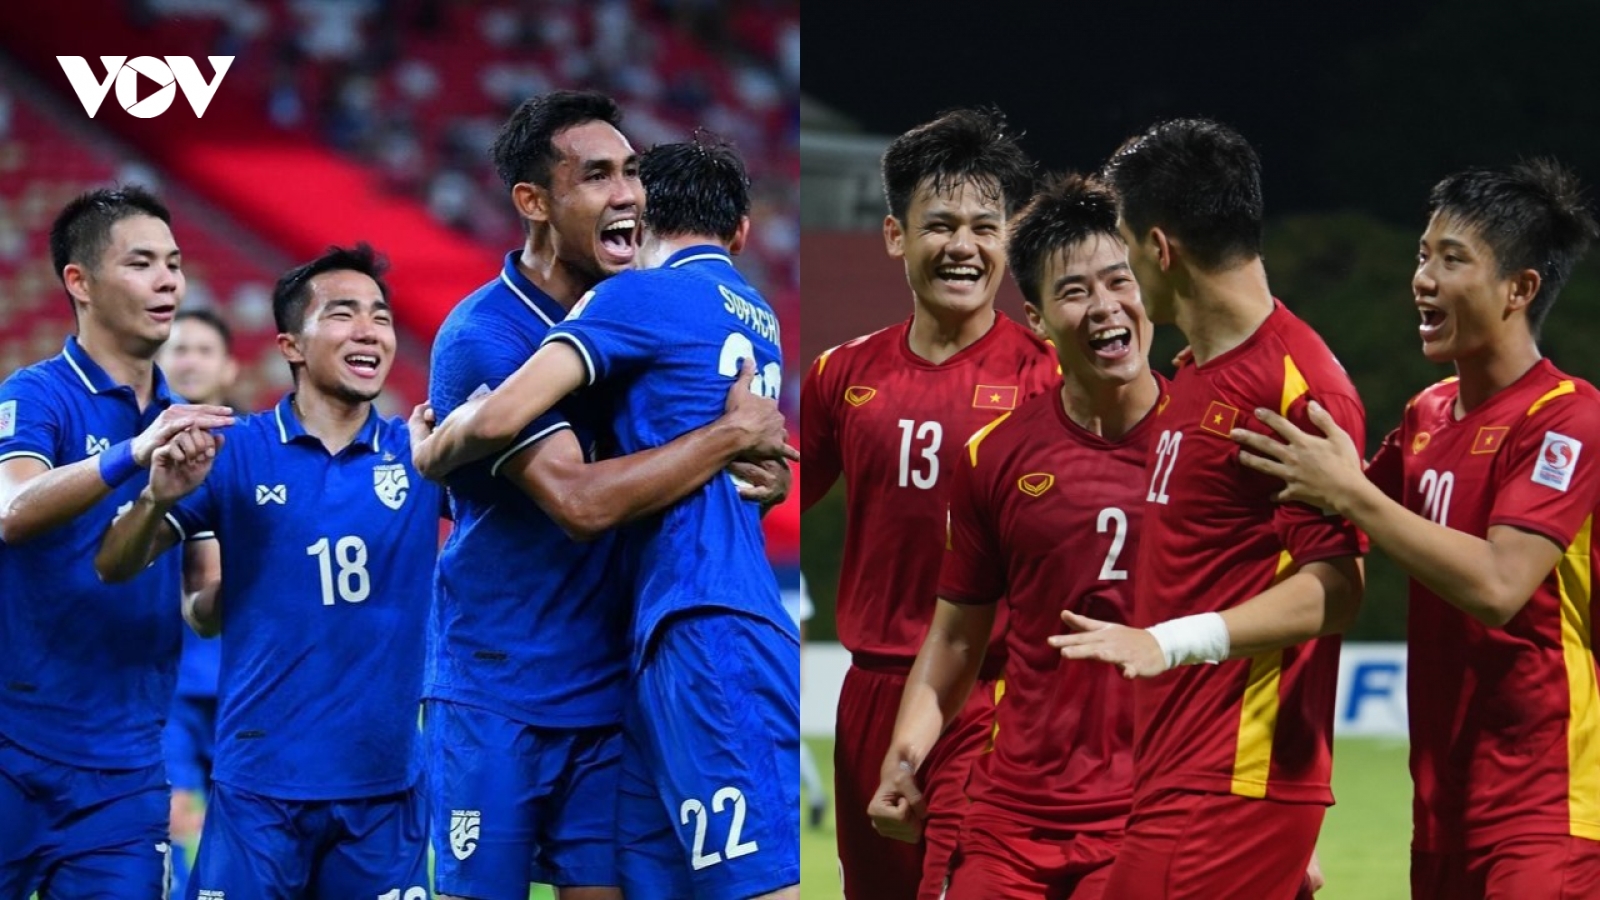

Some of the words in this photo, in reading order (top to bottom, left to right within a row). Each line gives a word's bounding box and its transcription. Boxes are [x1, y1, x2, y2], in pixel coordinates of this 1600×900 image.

[898, 418, 943, 490] 13
[1146, 429, 1183, 505] 22
[1418, 468, 1455, 528] 20
[306, 535, 371, 606] 18
[1096, 507, 1128, 581] 2
[680, 786, 759, 870] 22
